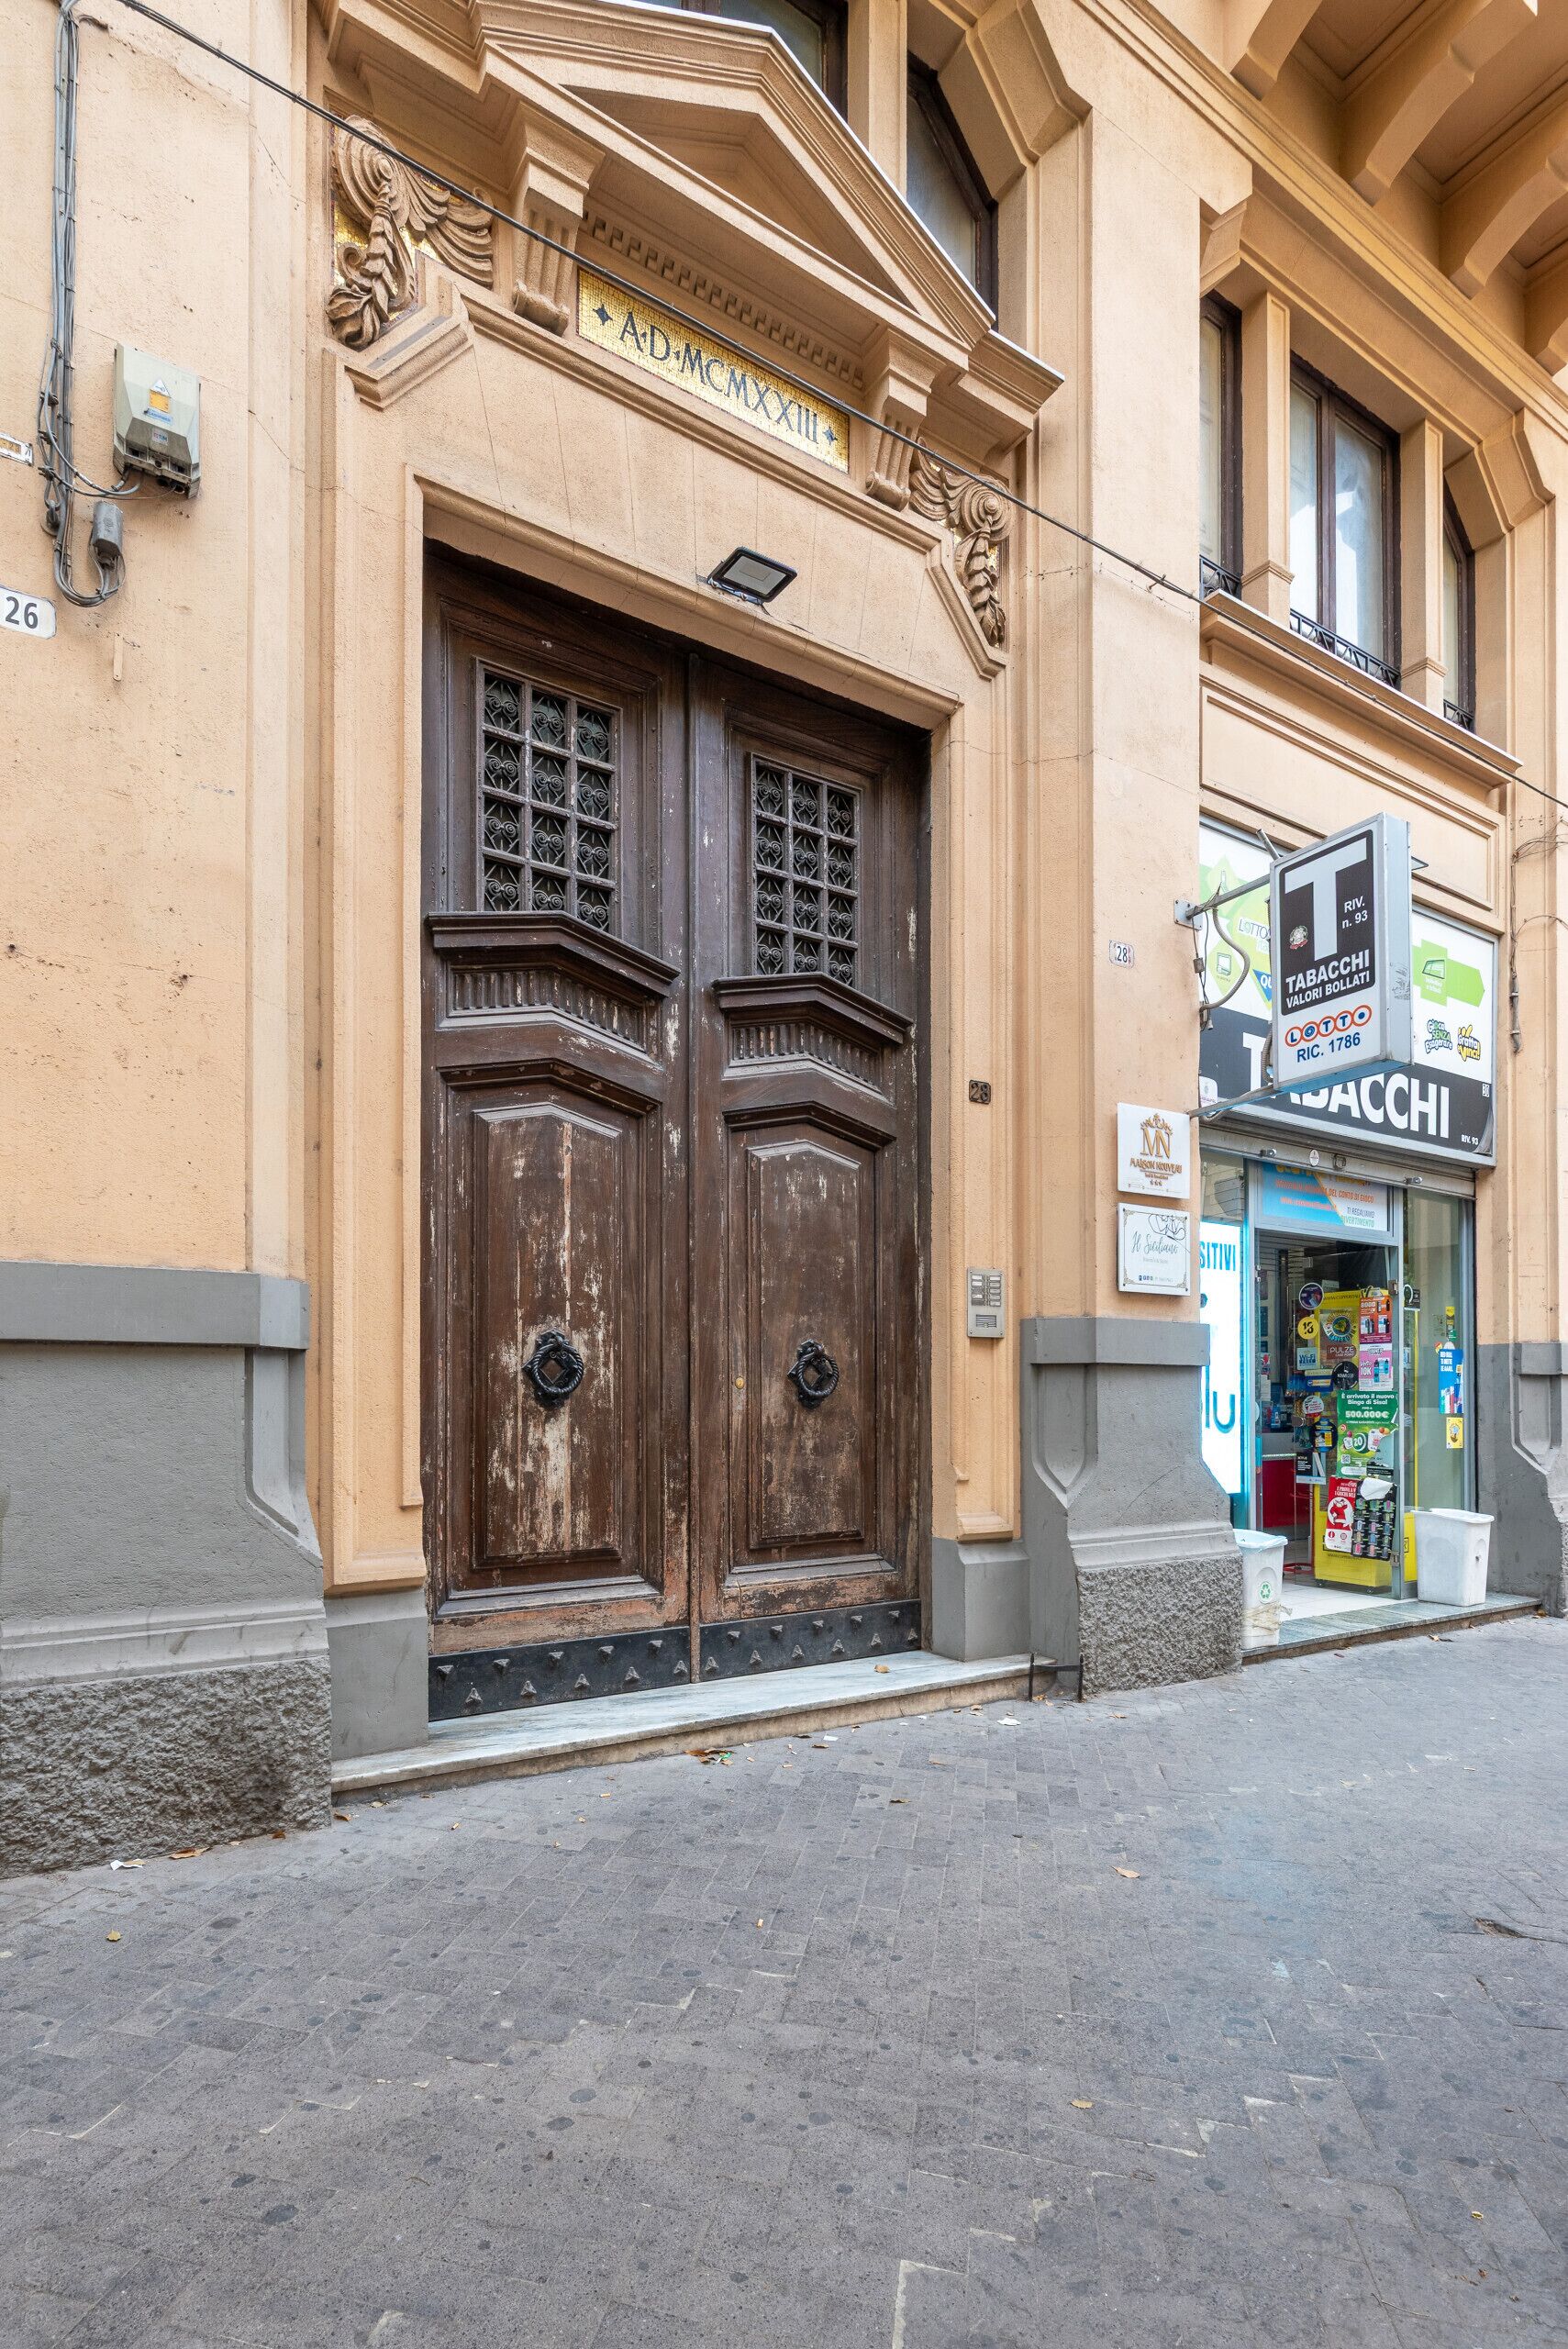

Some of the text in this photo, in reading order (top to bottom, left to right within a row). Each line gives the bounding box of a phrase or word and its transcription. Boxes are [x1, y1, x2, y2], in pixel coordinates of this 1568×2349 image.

[6, 596, 39, 629] 26
[1284, 837, 1367, 961] T
[1344, 896, 1365, 913] RIV.
[1341, 910, 1368, 930] n. 93
[1117, 945, 1128, 963] 28
[1285, 949, 1370, 994] TABACCHI
[1286, 986, 1323, 1008] VALORI
[1325, 970, 1370, 996] BOLLATI
[1284, 1005, 1373, 1047] LOTTO
[1296, 1032, 1361, 1063] RIC. 1786
[971, 1081, 991, 1102] 28
[1471, 1136, 1479, 1146] 93
[1329, 1346, 1354, 1354] PULZE
[1345, 1410, 1390, 1419] 500.000€
